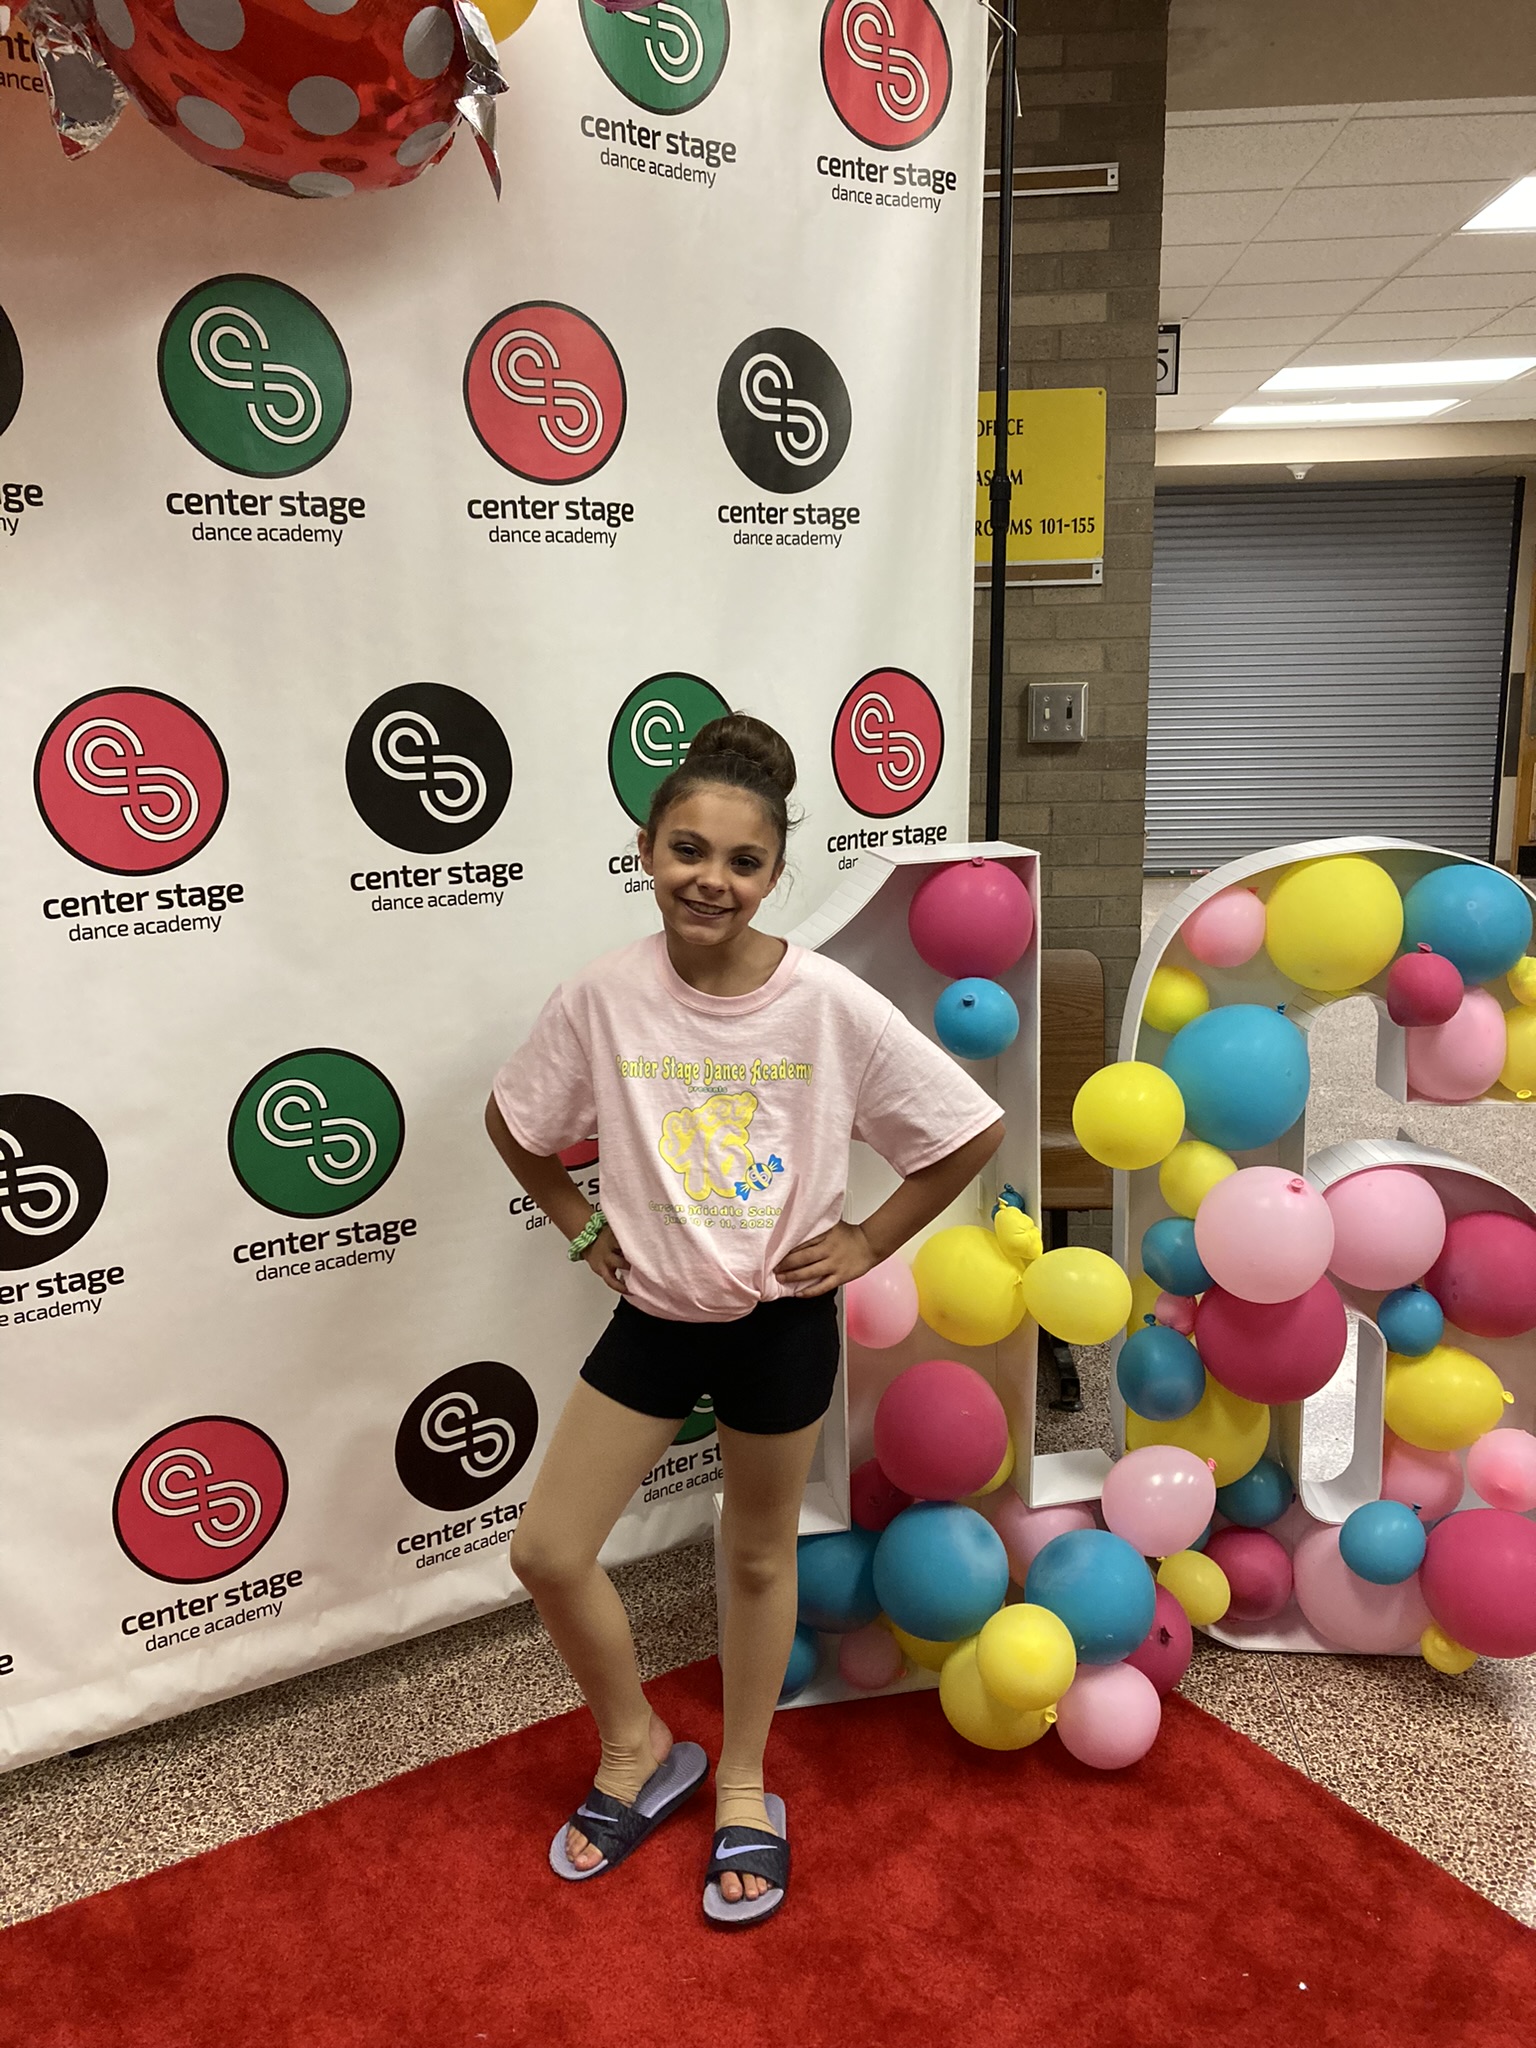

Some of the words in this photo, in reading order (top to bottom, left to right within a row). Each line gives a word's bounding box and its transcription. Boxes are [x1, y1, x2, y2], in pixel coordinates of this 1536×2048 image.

[581, 115, 662, 151] center
[666, 130, 736, 168] stage
[600, 147, 646, 173] dance
[648, 161, 716, 189] academy
[817, 155, 889, 184] center
[893, 163, 957, 194] stage
[831, 183, 873, 205] dance
[875, 193, 941, 214] academy
[166, 488, 273, 516] center
[279, 490, 366, 525] stage
[467, 495, 560, 520] center
[565, 496, 634, 528] stage
[717, 502, 789, 525] center
[793, 503, 860, 530] stage
[192, 521, 253, 542] dance
[257, 523, 343, 547] academy
[488, 525, 541, 543] dance
[545, 526, 617, 549] academy
[733, 529, 773, 546] dance
[775, 530, 842, 549] academy
[1039, 516, 1096, 535] 101-155
[827, 828, 889, 853] center
[350, 865, 442, 892] center
[447, 861, 524, 888] stage
[624, 877, 656, 894] danc
[43, 889, 150, 920] center
[155, 883, 244, 912] stage
[371, 895, 424, 912] dance
[427, 889, 504, 908] academy
[68, 923, 129, 942] dance
[133, 914, 222, 936] academy
[615, 1054, 659, 1079] enter
[661, 1055, 701, 1086] Stage
[703, 1056, 747, 1086] Dance
[750, 1057, 814, 1087] Academy
[688, 1204, 743, 1217] Middle
[747, 1205, 783, 1217] Scho
[704, 1218, 715, 1228] &
[740, 1219, 775, 1229] 2022
[233, 1230, 331, 1264] center
[335, 1218, 417, 1247] stage
[255, 1261, 311, 1282] dance
[314, 1247, 396, 1272] academy
[35, 1266, 125, 1299] stage
[13, 1297, 102, 1325] academy
[640, 1451, 699, 1487] enter
[643, 1480, 684, 1503] dance
[685, 1467, 724, 1489] acade
[396, 1516, 477, 1555] center
[415, 1546, 462, 1569] dance
[121, 1592, 220, 1637] center
[224, 1569, 303, 1608] stage
[145, 1626, 201, 1652] dance
[204, 1599, 283, 1636] academy
